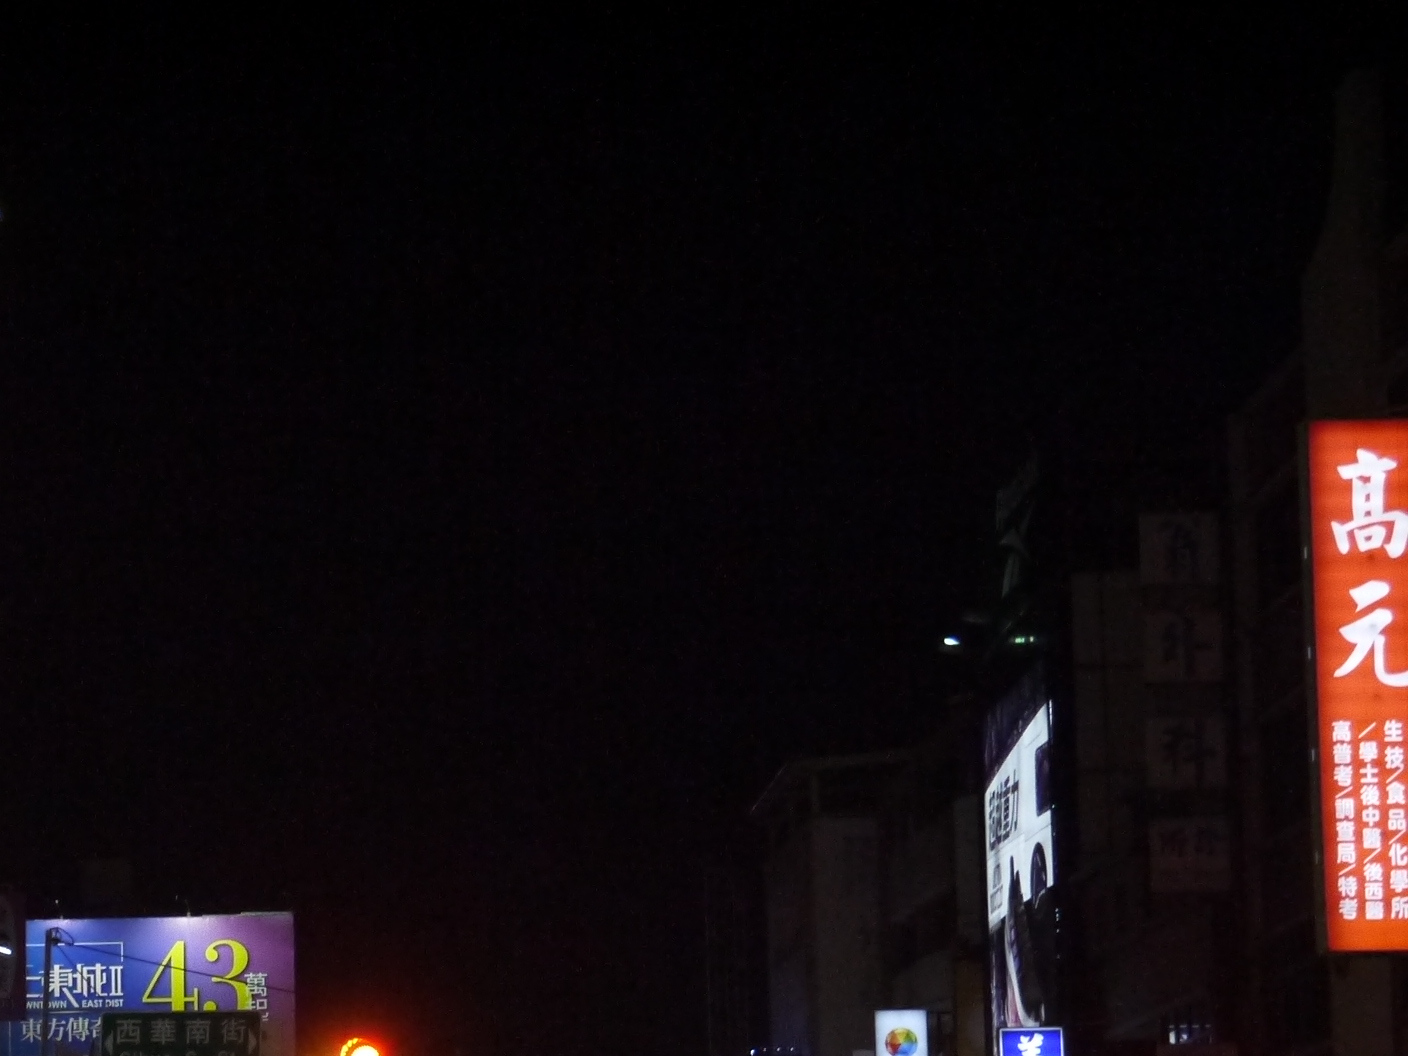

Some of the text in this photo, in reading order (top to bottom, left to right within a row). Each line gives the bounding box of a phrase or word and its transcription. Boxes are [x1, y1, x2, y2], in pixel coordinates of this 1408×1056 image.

[81, 999, 103, 1008] EAST
[105, 999, 124, 1008] DIST
[115, 1018, 247, 1046] 西華南街
